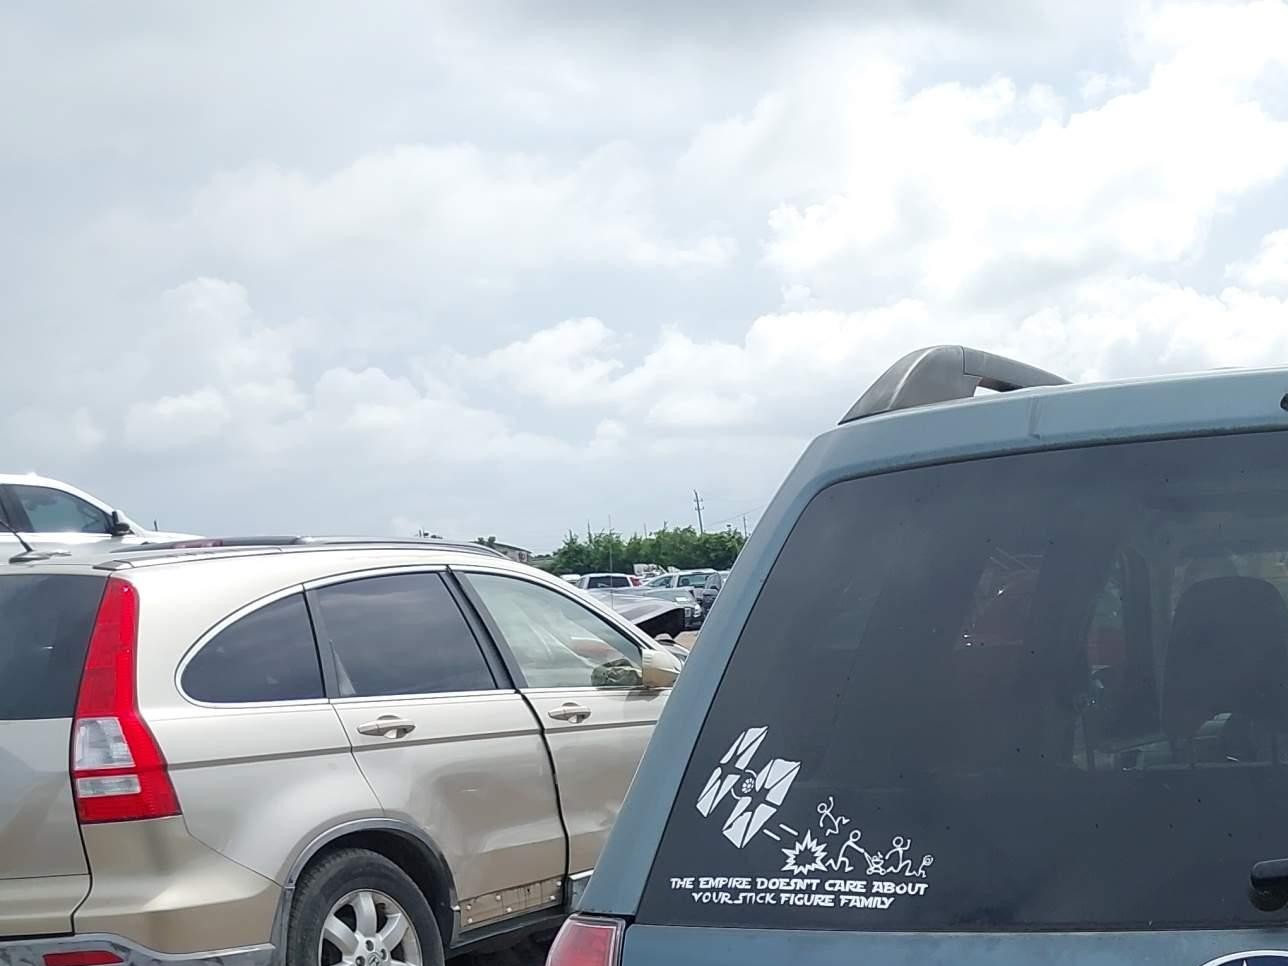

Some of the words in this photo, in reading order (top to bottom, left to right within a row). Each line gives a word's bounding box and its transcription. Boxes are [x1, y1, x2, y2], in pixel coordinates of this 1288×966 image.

[670, 877, 695, 889] THE
[699, 877, 752, 889] EMPIRE
[756, 877, 820, 891] DOESN'T
[825, 879, 867, 893] CARE
[872, 881, 929, 896] ABOUT
[692, 891, 734, 905] YOUR
[734, 892, 777, 905] STICK
[780, 893, 835, 907] FIGURE
[840, 895, 895, 909] FAMILY
